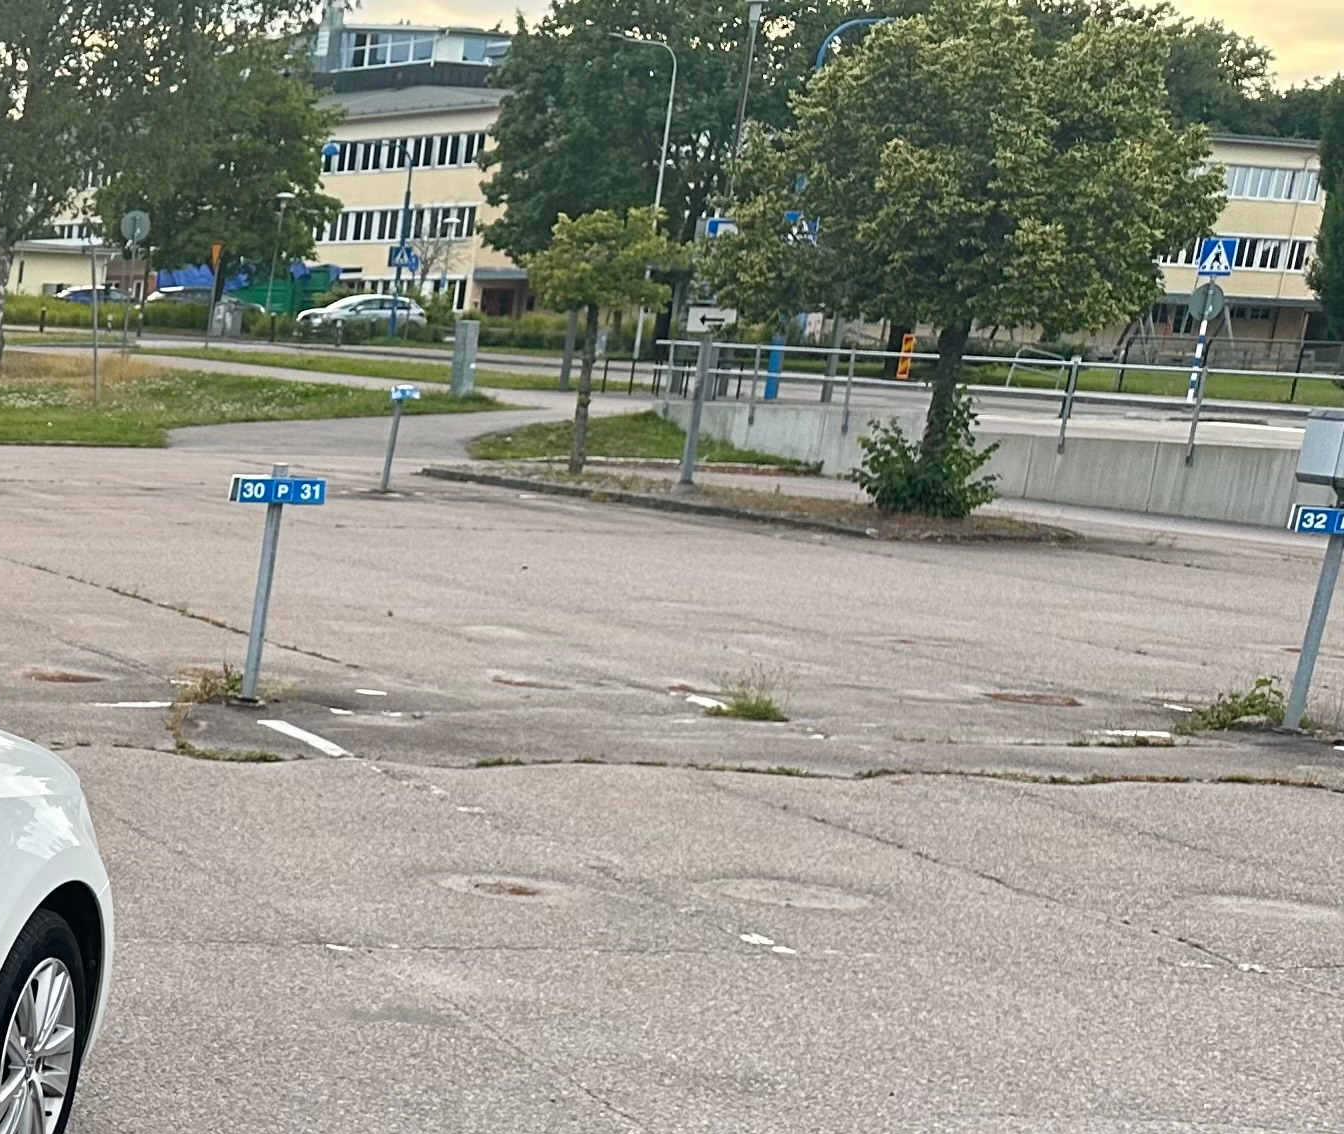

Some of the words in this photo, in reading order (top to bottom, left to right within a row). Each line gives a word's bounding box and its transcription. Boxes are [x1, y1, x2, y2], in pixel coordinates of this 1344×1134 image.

[242, 482, 266, 499] 30
[277, 484, 289, 498] P
[300, 483, 321, 500] 31
[1302, 512, 1328, 529] 32
